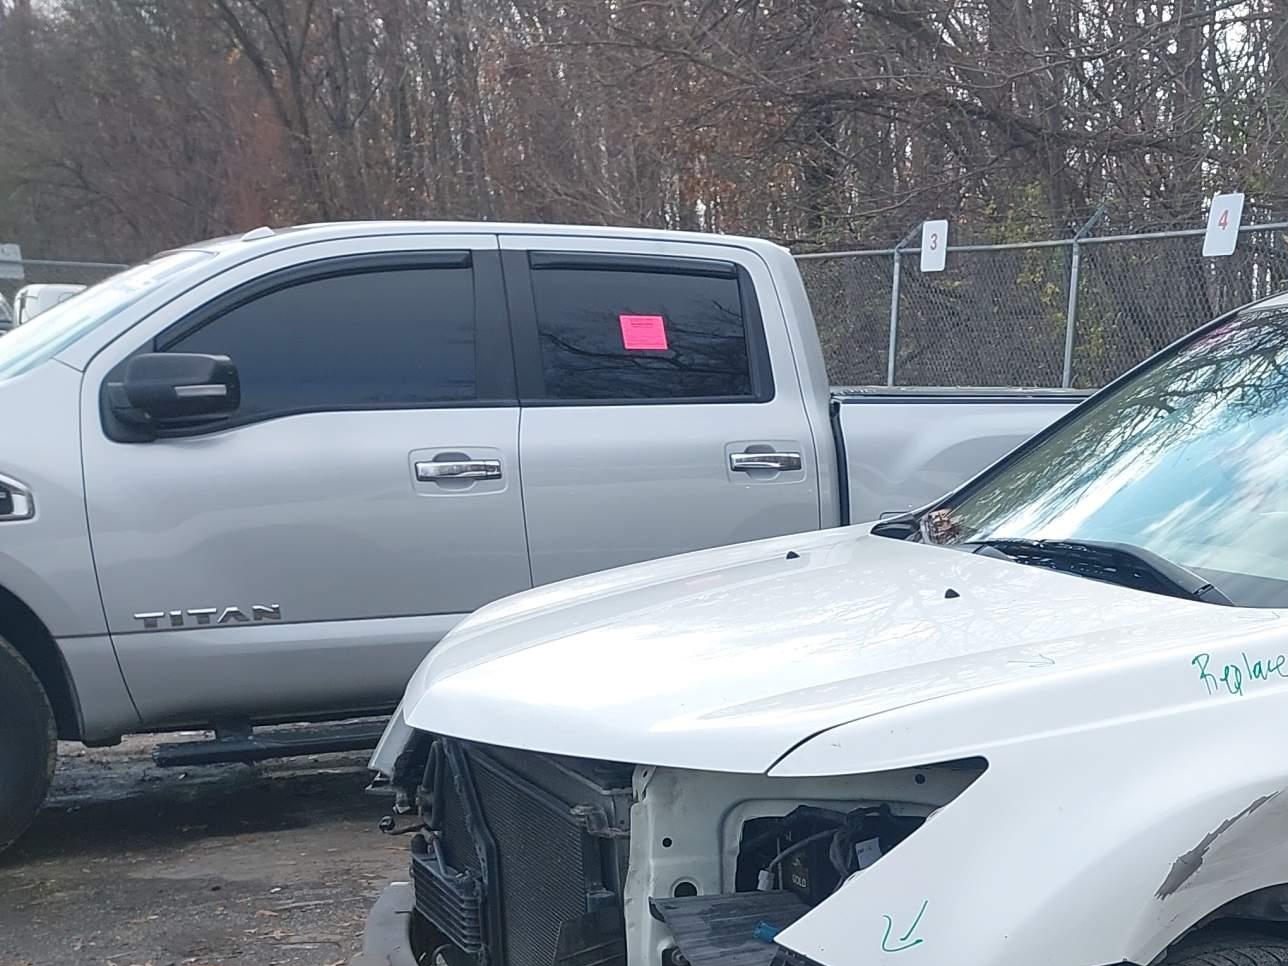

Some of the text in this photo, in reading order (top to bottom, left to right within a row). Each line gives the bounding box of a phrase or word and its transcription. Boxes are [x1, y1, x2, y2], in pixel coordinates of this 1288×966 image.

[1217, 209, 1229, 231] 4
[930, 233, 938, 251] 3
[133, 603, 282, 629] TITAN
